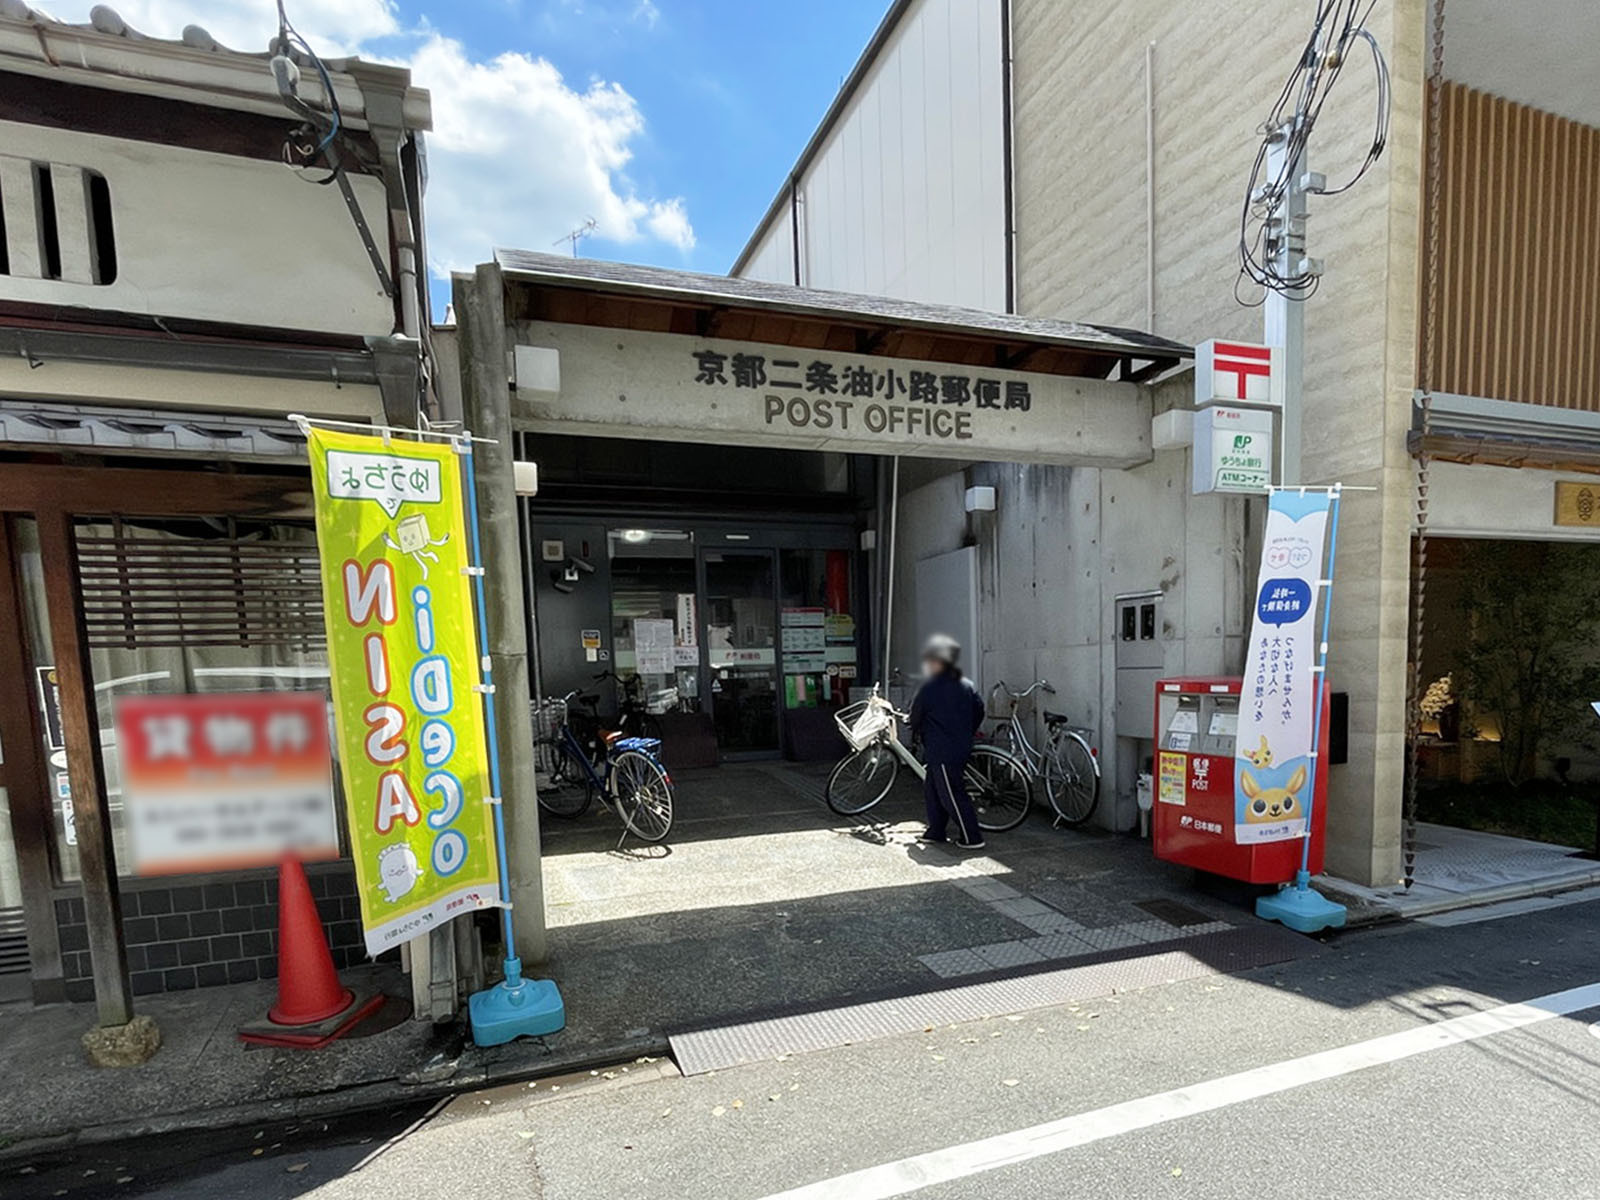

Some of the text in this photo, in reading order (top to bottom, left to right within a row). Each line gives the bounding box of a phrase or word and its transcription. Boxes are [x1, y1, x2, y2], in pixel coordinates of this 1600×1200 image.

[692, 350, 1031, 412] 京都二条油小路郵便局
[764, 395, 973, 439] POST OFFICE
[1221, 456, 1262, 468] ゆうちょ銀行
[1221, 473, 1265, 484] ATMコーナー
[1192, 779, 1209, 791] POST
